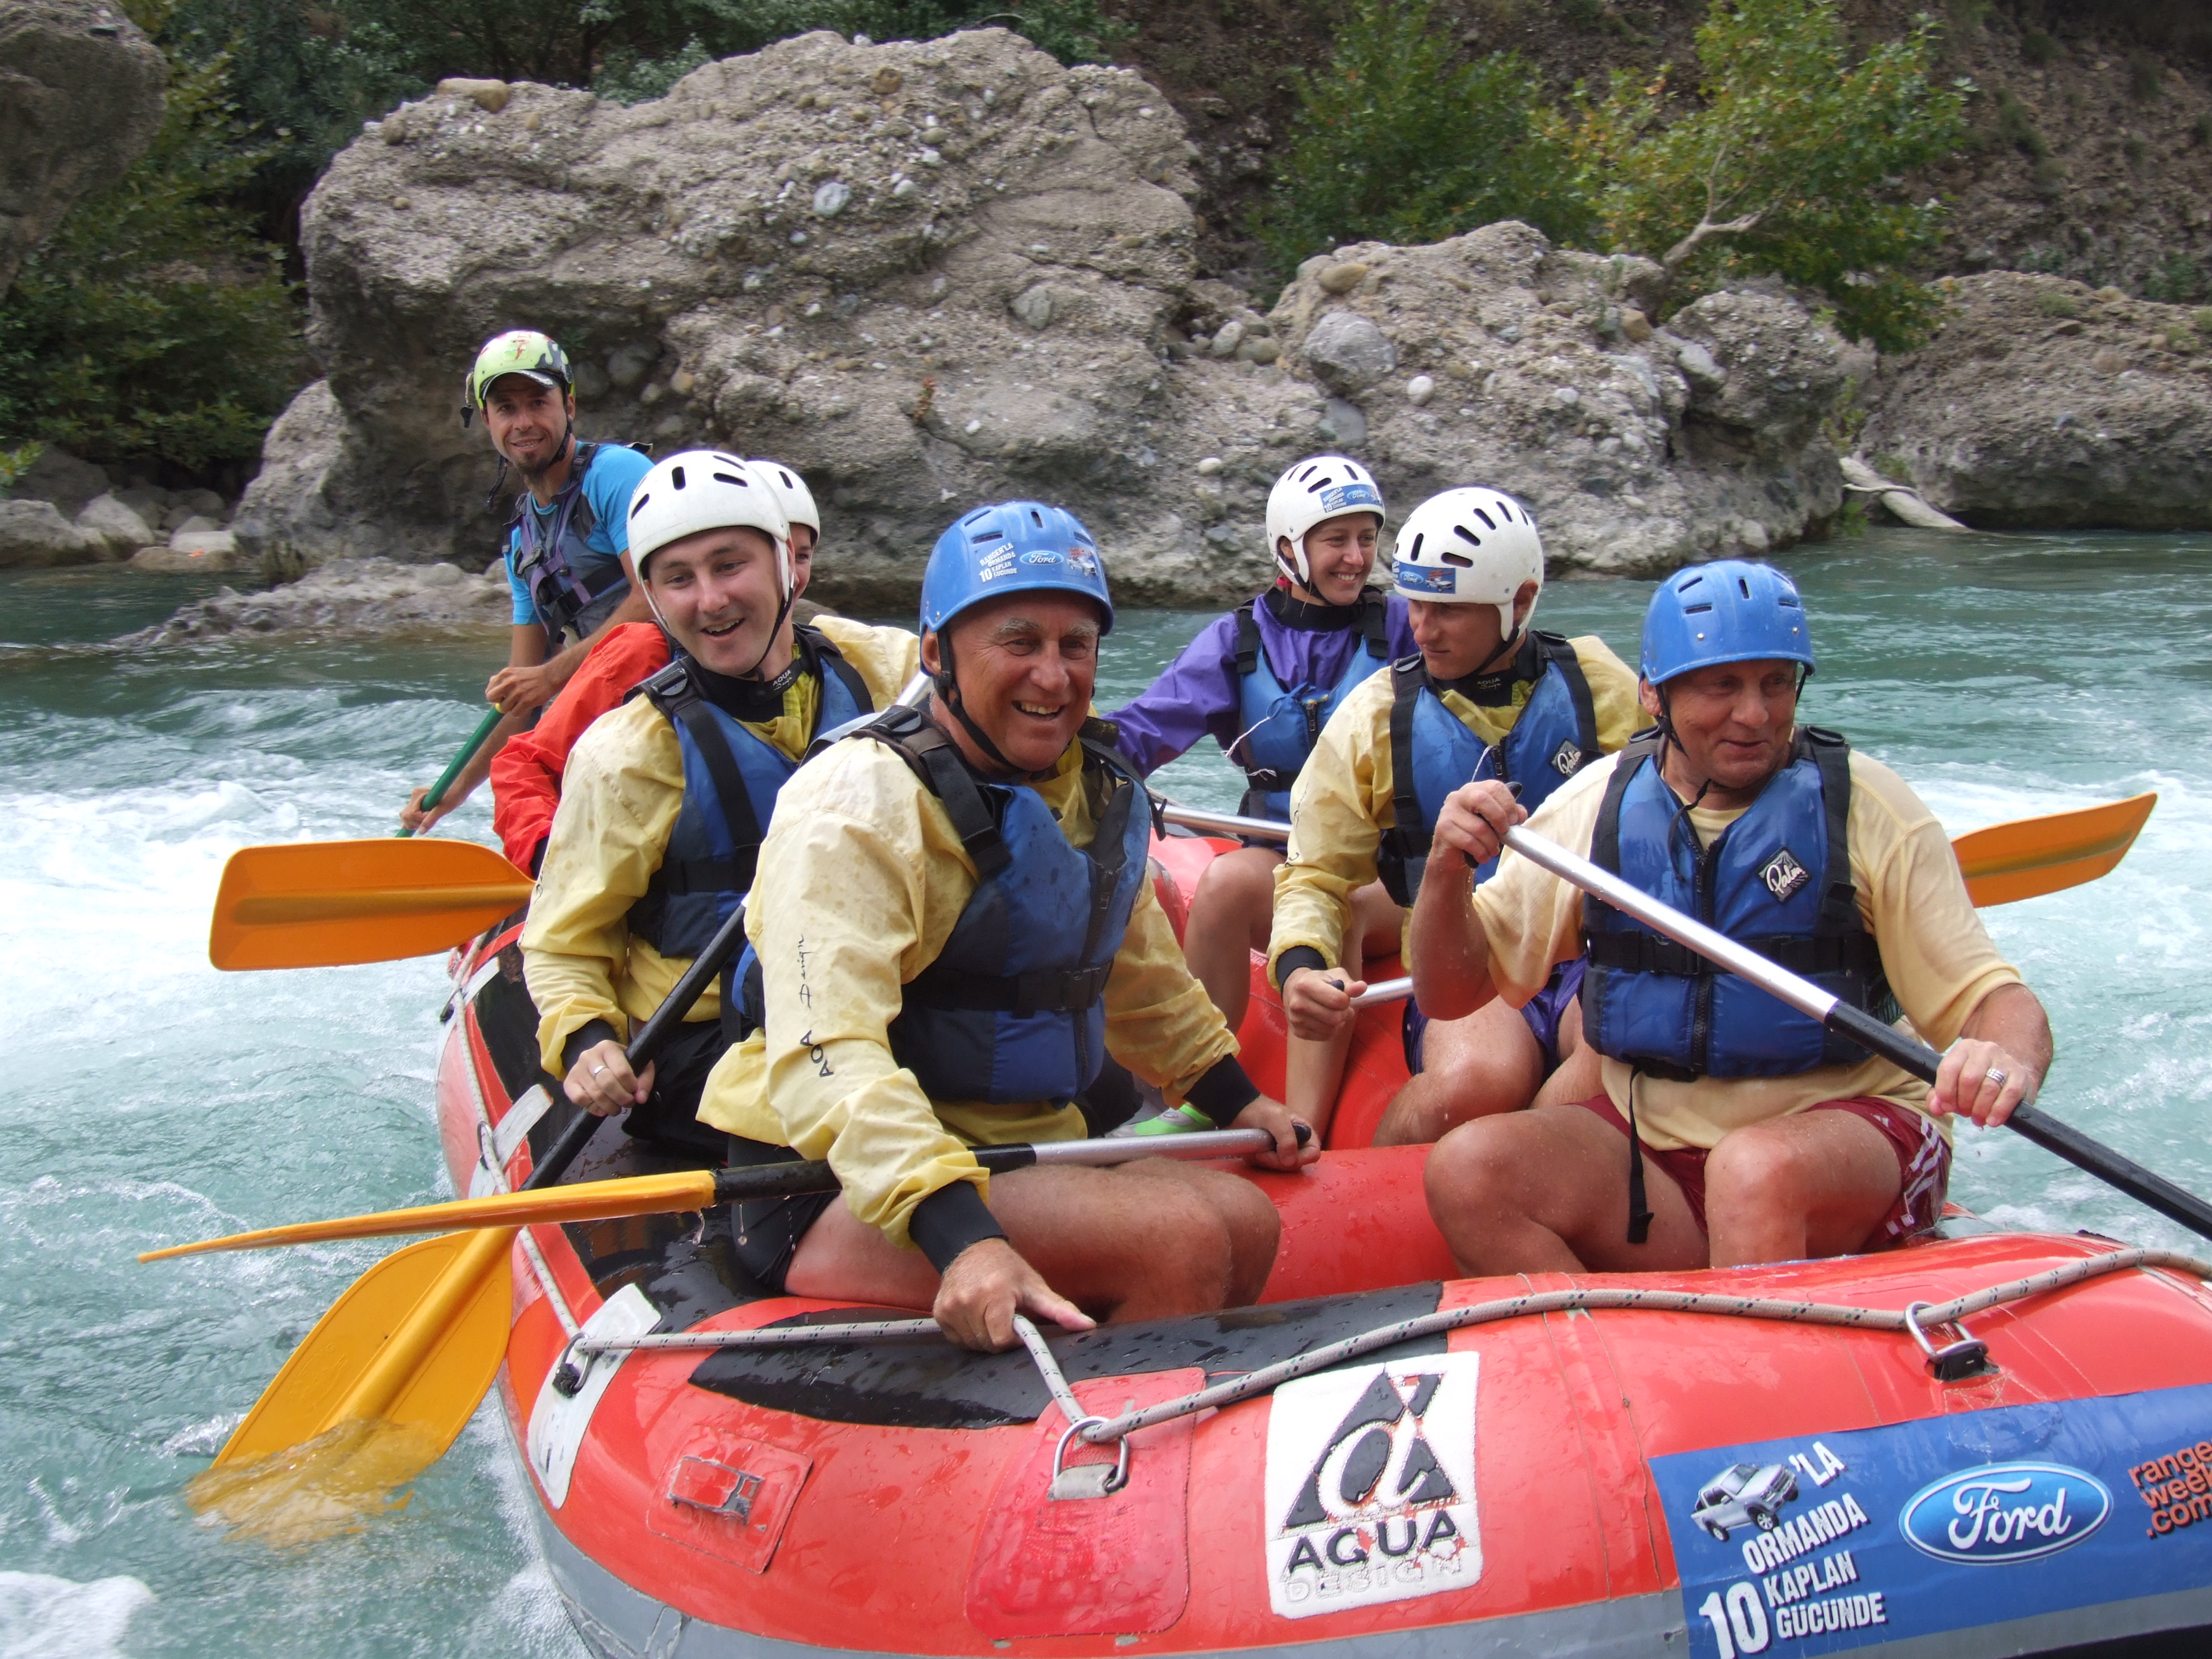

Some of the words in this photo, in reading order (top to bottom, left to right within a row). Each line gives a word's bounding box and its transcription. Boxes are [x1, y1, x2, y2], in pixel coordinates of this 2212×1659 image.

[979, 568, 993, 582] 10
[1029, 552, 1056, 563] Ford
[772, 670, 791, 686] AQUA
[2128, 1438, 2212, 1488] range
[1289, 1510, 1456, 1574] AQUA
[1742, 1492, 1869, 1575] ORMANDA
[1948, 1478, 2072, 1550] Ford
[1762, 1550, 1858, 1608] KAPLAN
[1698, 1582, 1773, 1659] 10
